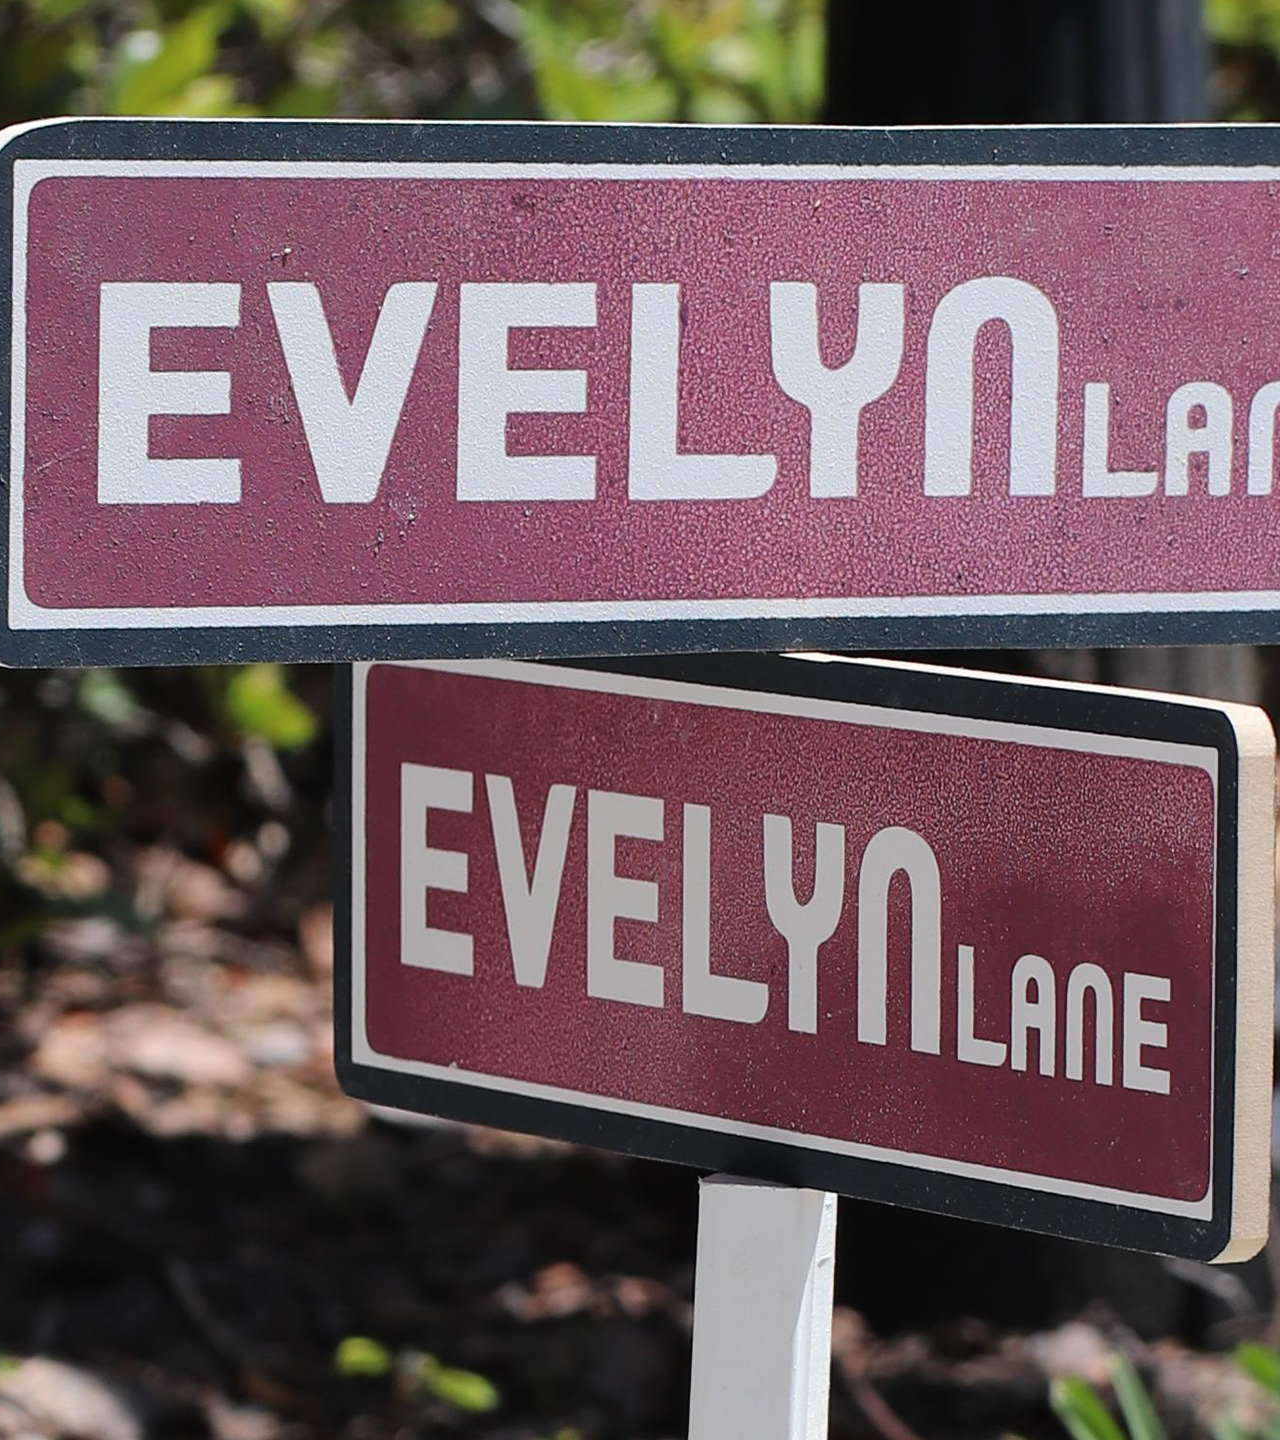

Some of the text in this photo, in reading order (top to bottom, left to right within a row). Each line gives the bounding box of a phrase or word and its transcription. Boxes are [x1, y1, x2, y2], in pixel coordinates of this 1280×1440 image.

[96, 276, 1061, 507] EVELYN
[399, 762, 1173, 1096] EVELYN LANE
